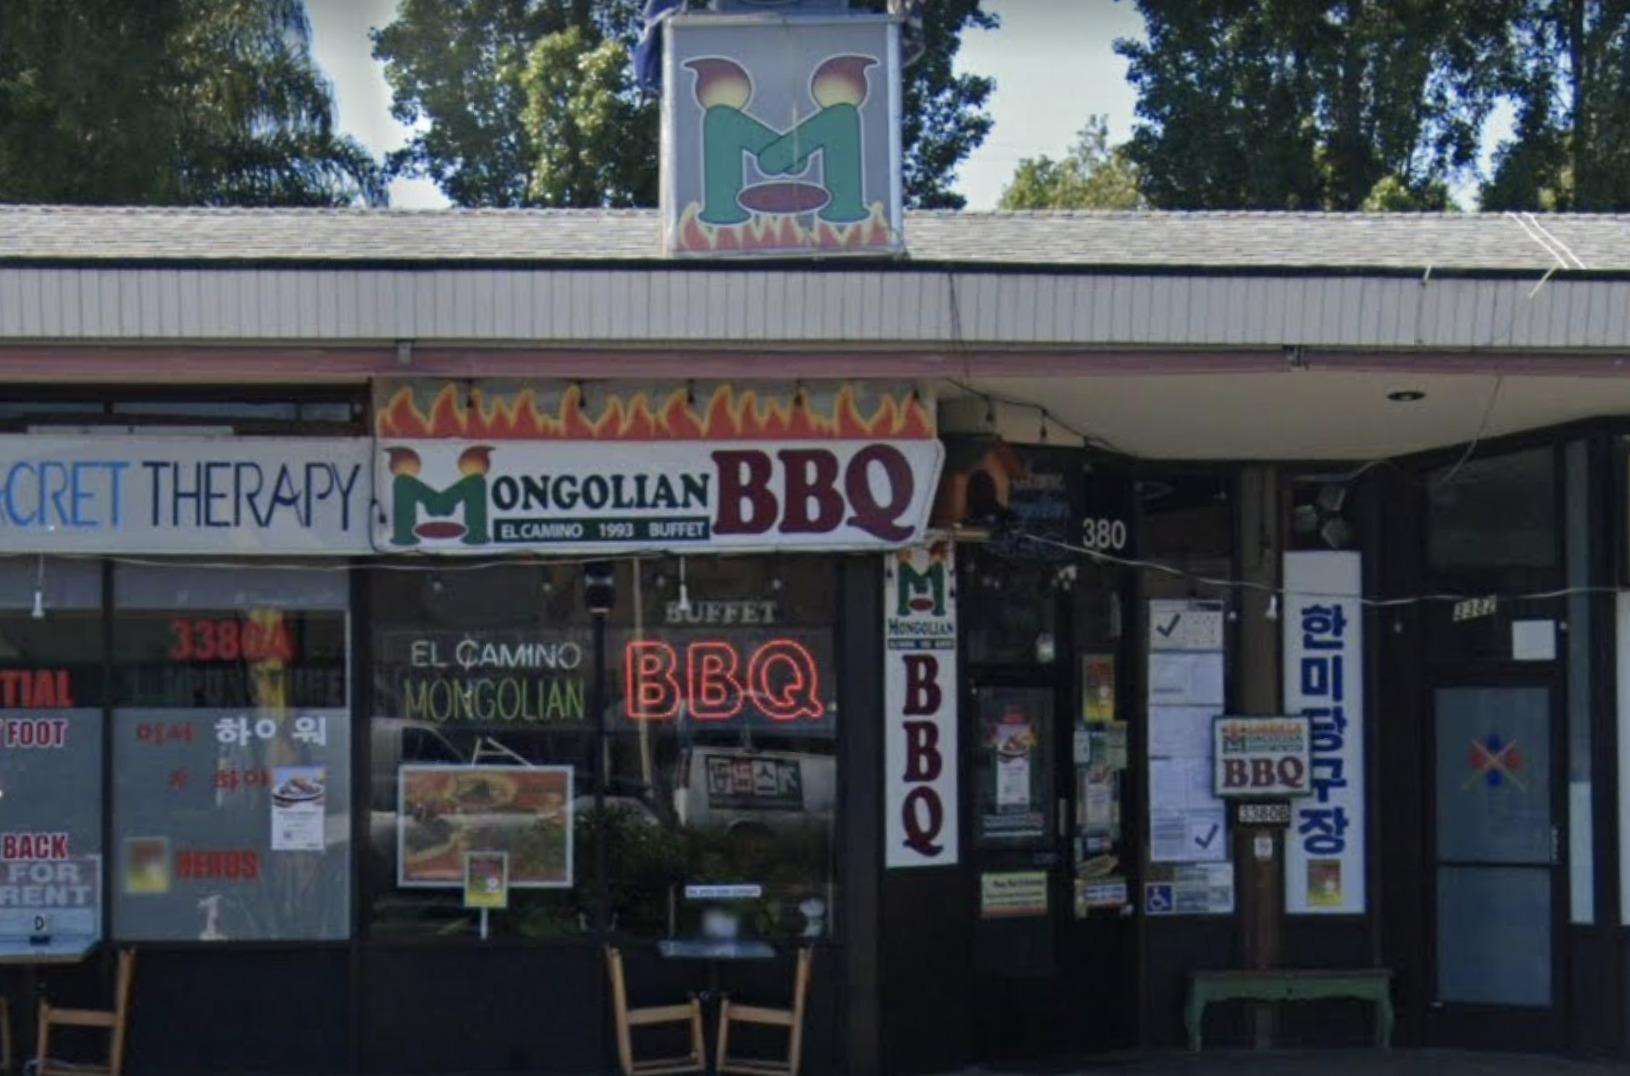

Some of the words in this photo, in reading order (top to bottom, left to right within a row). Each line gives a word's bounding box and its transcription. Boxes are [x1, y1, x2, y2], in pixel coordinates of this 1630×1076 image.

[0, 461, 130, 527] CRET
[142, 461, 361, 531] THERAPY
[712, 443, 916, 542] BBQ
[521, 523, 584, 539] CAMINO
[599, 522, 633, 538] 1993
[651, 521, 705, 538] BUFFET
[1082, 517, 1127, 550] 380
[665, 600, 778, 624] BUFFET
[411, 640, 448, 668] EL
[455, 639, 582, 670] CAMINO
[625, 638, 824, 719] BBQ
[404, 677, 585, 720] MONGOLIAN
[7, 718, 67, 748] FOOT
[902, 653, 944, 857] BBQ
[1222, 756, 1304, 788] BBQ
[3, 834, 67, 859] BACK
[9, 862, 79, 883] FOR
[0, 885, 91, 906] RENT
